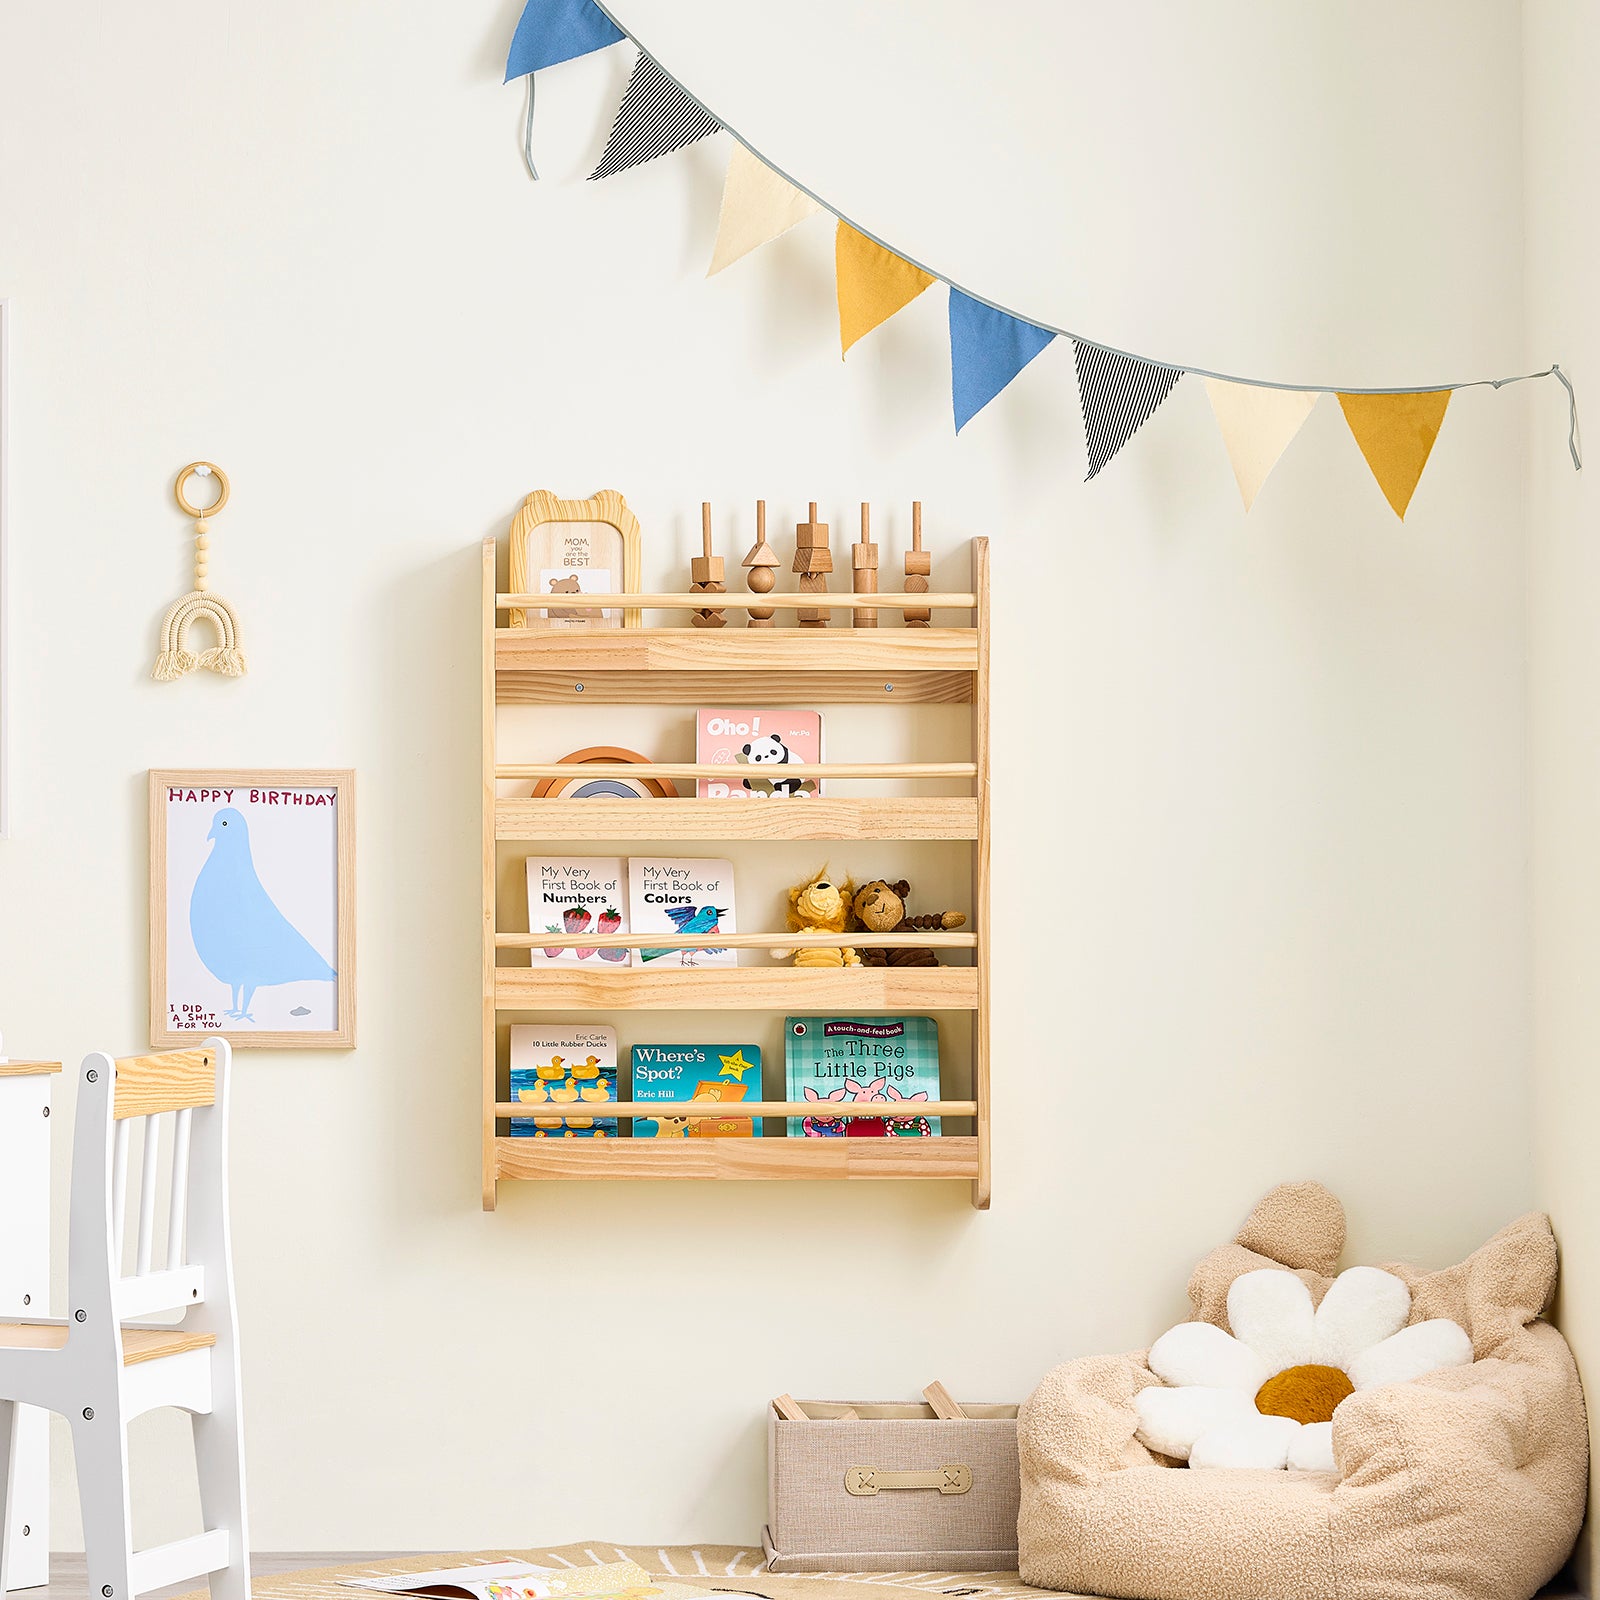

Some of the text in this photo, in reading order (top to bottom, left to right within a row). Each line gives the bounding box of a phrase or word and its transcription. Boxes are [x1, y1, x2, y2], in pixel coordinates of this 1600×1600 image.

[564, 538, 590, 546] MOM,
[563, 557, 590, 567] BEST
[707, 717, 761, 737] Oho!
[169, 788, 337, 806] HAPPY BIRTHDAY
[541, 866, 591, 880] My Very
[643, 866, 691, 880] My Very
[542, 880, 618, 891] First Book of
[643, 880, 720, 892] First Book of
[543, 893, 607, 904] Numbers
[644, 893, 692, 904] Colors
[170, 1004, 203, 1013] I DID
[172, 1013, 216, 1022] A SHIT
[201, 1021, 222, 1029] YOU
[834, 1024, 886, 1035] touch-and-feel
[885, 1025, 902, 1035] book
[824, 1039, 905, 1058] The Three
[636, 1065, 683, 1082] Spot?
[814, 1062, 915, 1081] Little Pigs
[636, 1090, 675, 1098] Eric Hill
